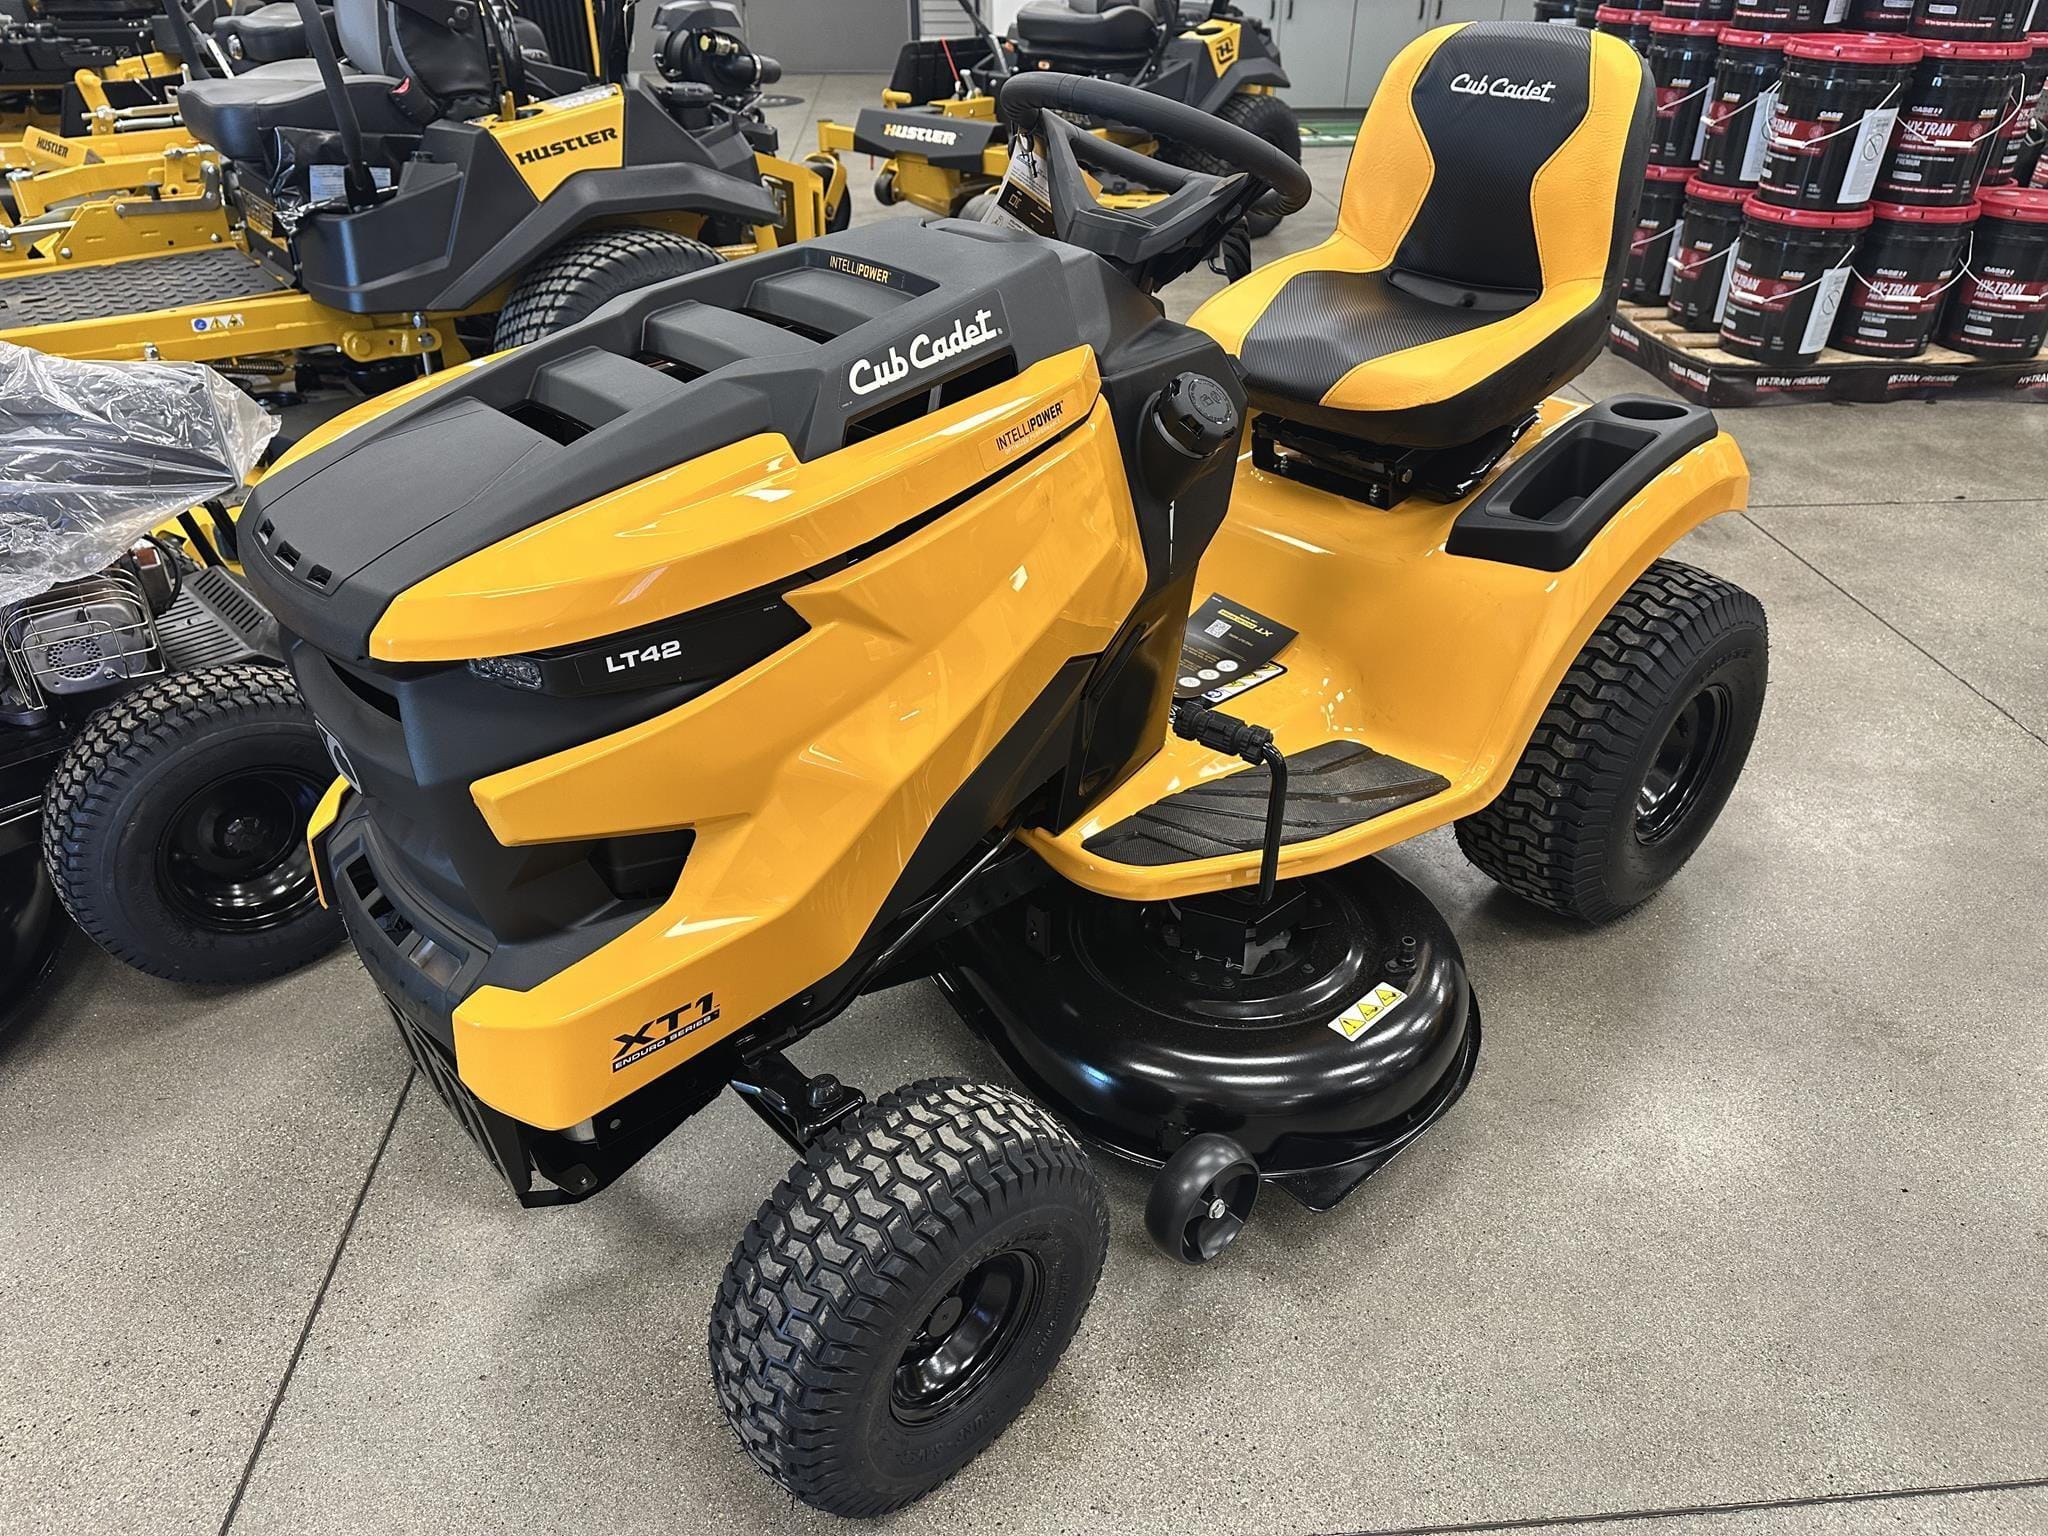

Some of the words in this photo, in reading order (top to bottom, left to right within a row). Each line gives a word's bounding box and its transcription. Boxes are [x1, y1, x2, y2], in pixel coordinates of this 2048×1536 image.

[1450, 73, 1488, 95] Cub
[1489, 77, 1556, 102] Cadet
[37, 136, 69, 158] HUSTLER
[515, 127, 618, 165] HUSTLER
[884, 123, 957, 146] HUSTLER
[829, 255, 889, 284] INTELLIPOWER
[849, 346, 909, 395] Cub
[909, 308, 997, 370] Cadet
[995, 401, 1063, 451] INTELLIPOWER
[605, 640, 682, 673] LT42
[611, 991, 714, 1061] XT1
[614, 1039, 666, 1070] ENDURO
[669, 1015, 711, 1042] SERIES
